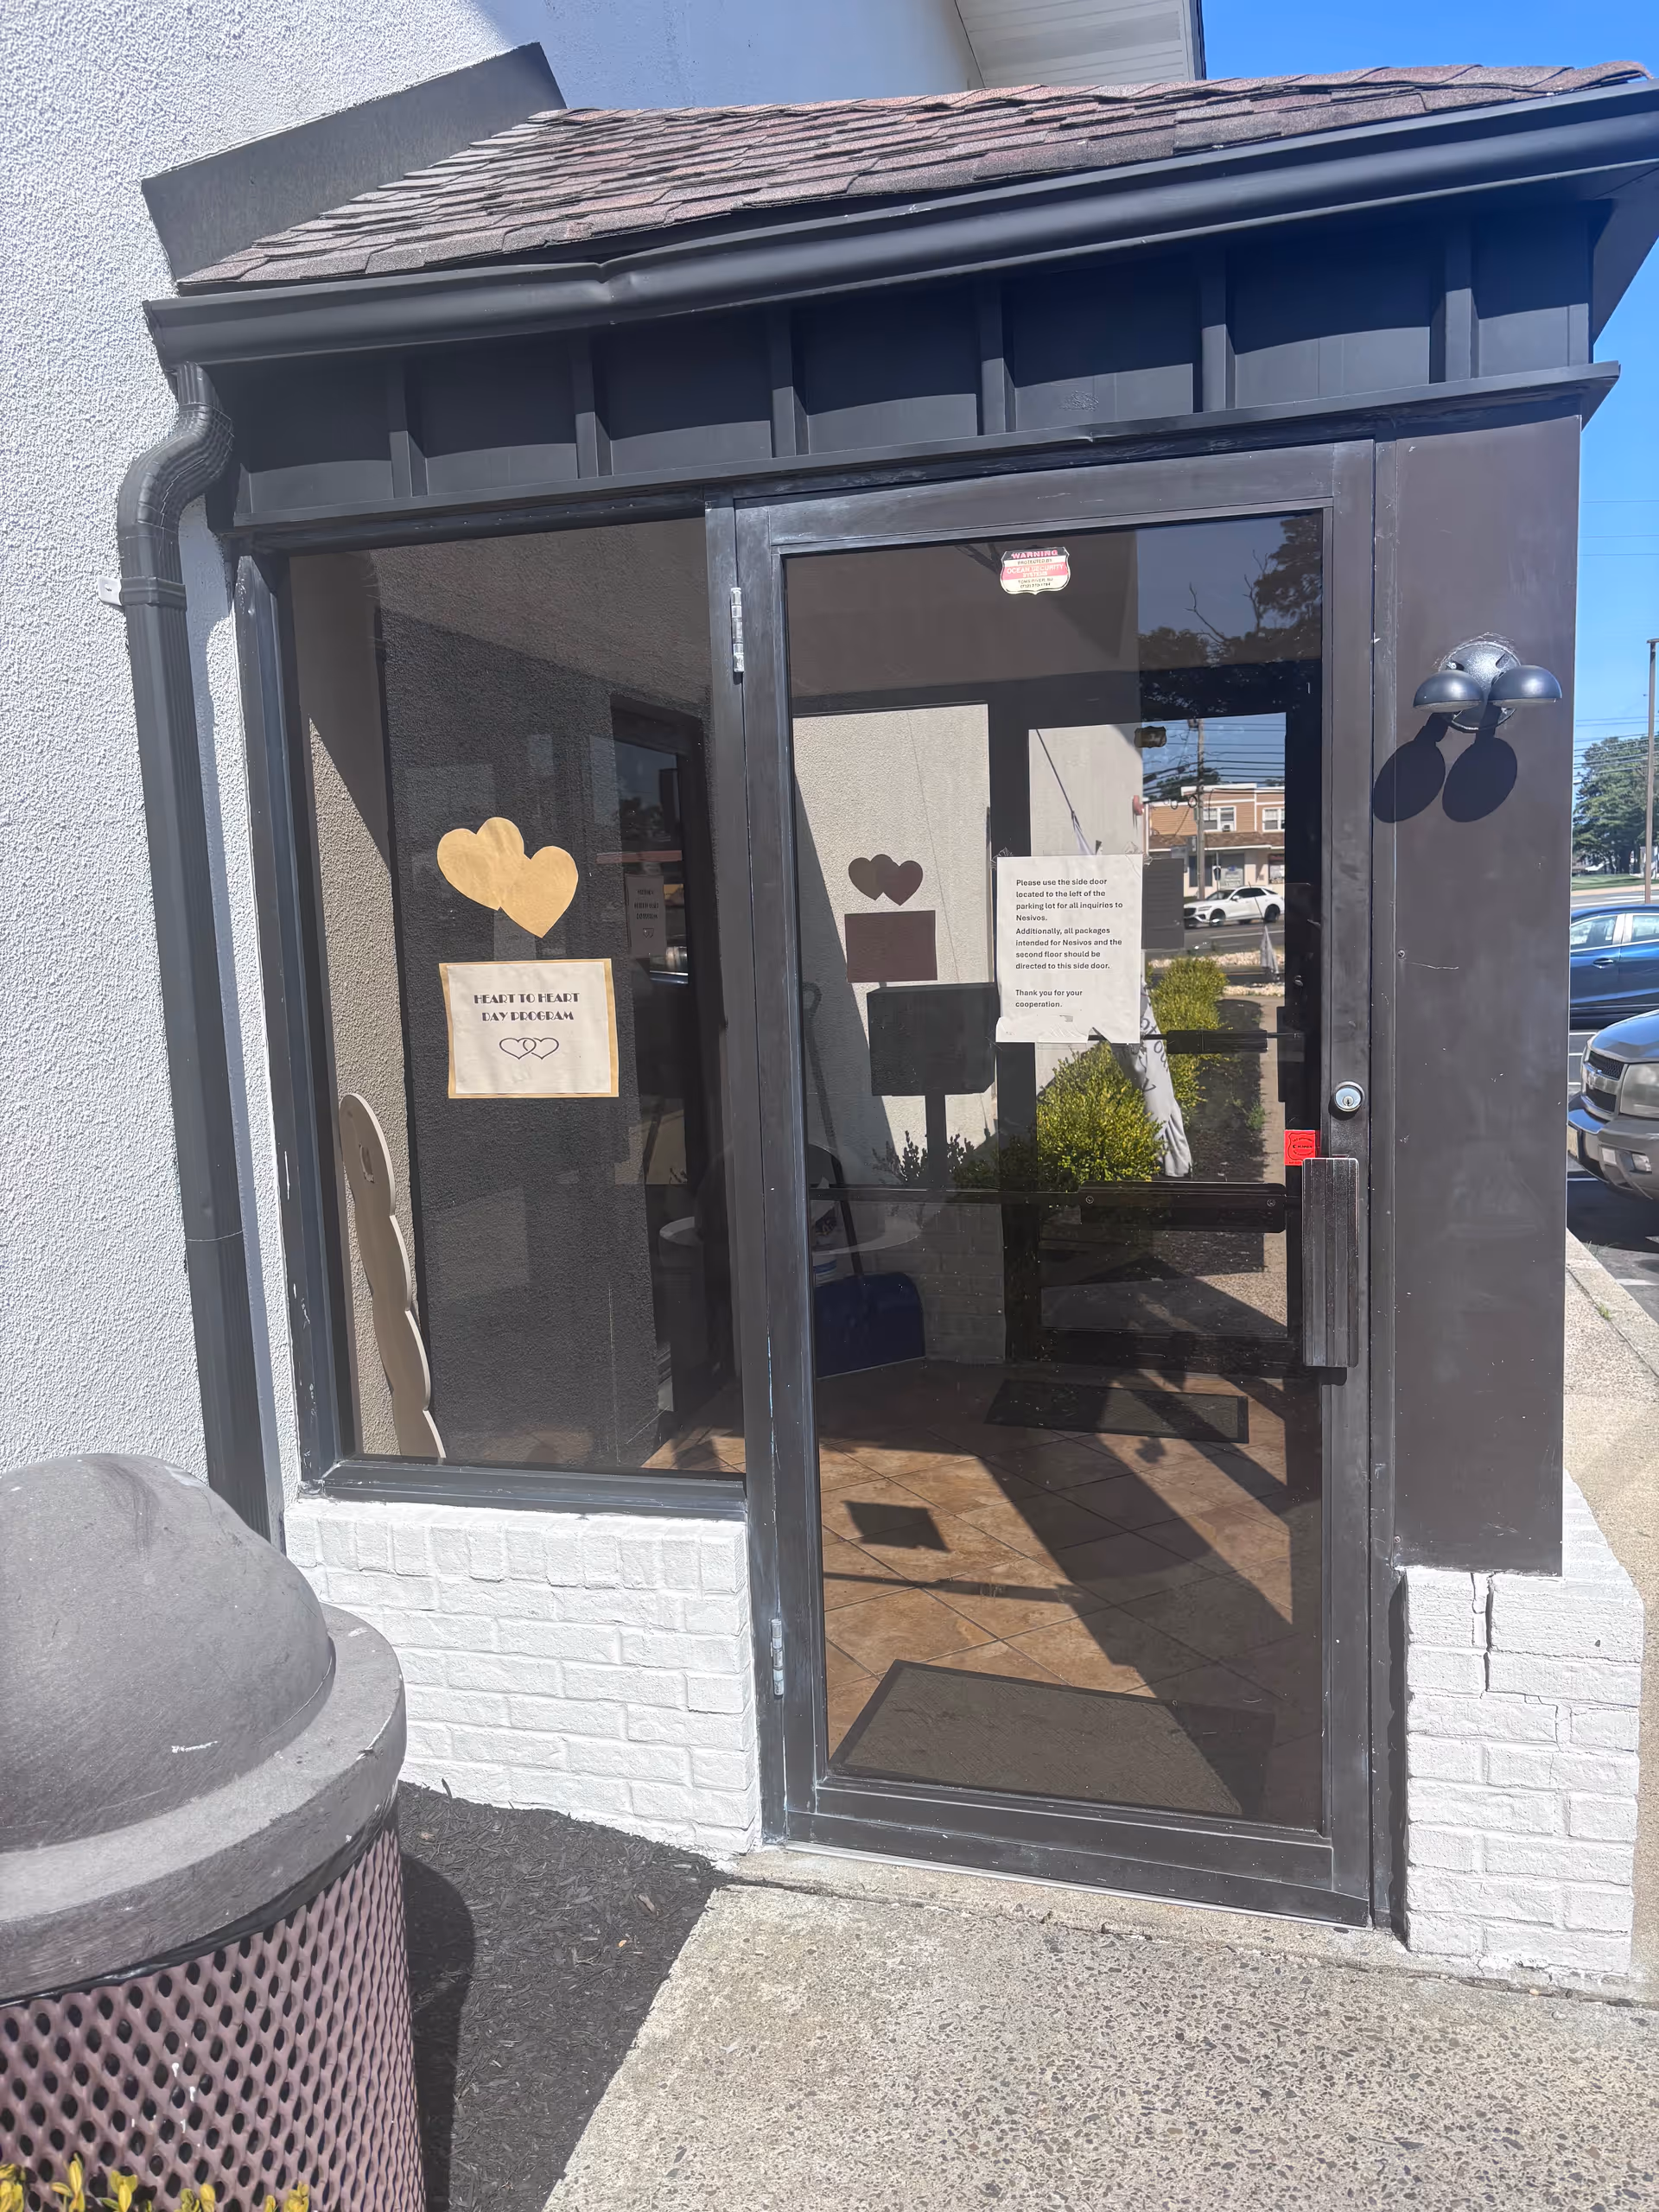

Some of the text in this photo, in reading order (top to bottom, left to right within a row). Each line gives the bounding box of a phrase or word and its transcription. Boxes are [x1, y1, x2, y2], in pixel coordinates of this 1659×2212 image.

[1011, 550, 1058, 559] WARNING
[1032, 563, 1065, 572] SECURITY
[1080, 901, 1114, 910] inquiries
[474, 993, 580, 1005] HEART TO HEART
[1015, 1001, 1063, 1009] cooperation.
[481, 1010, 575, 1022] DAY PROGRAM
